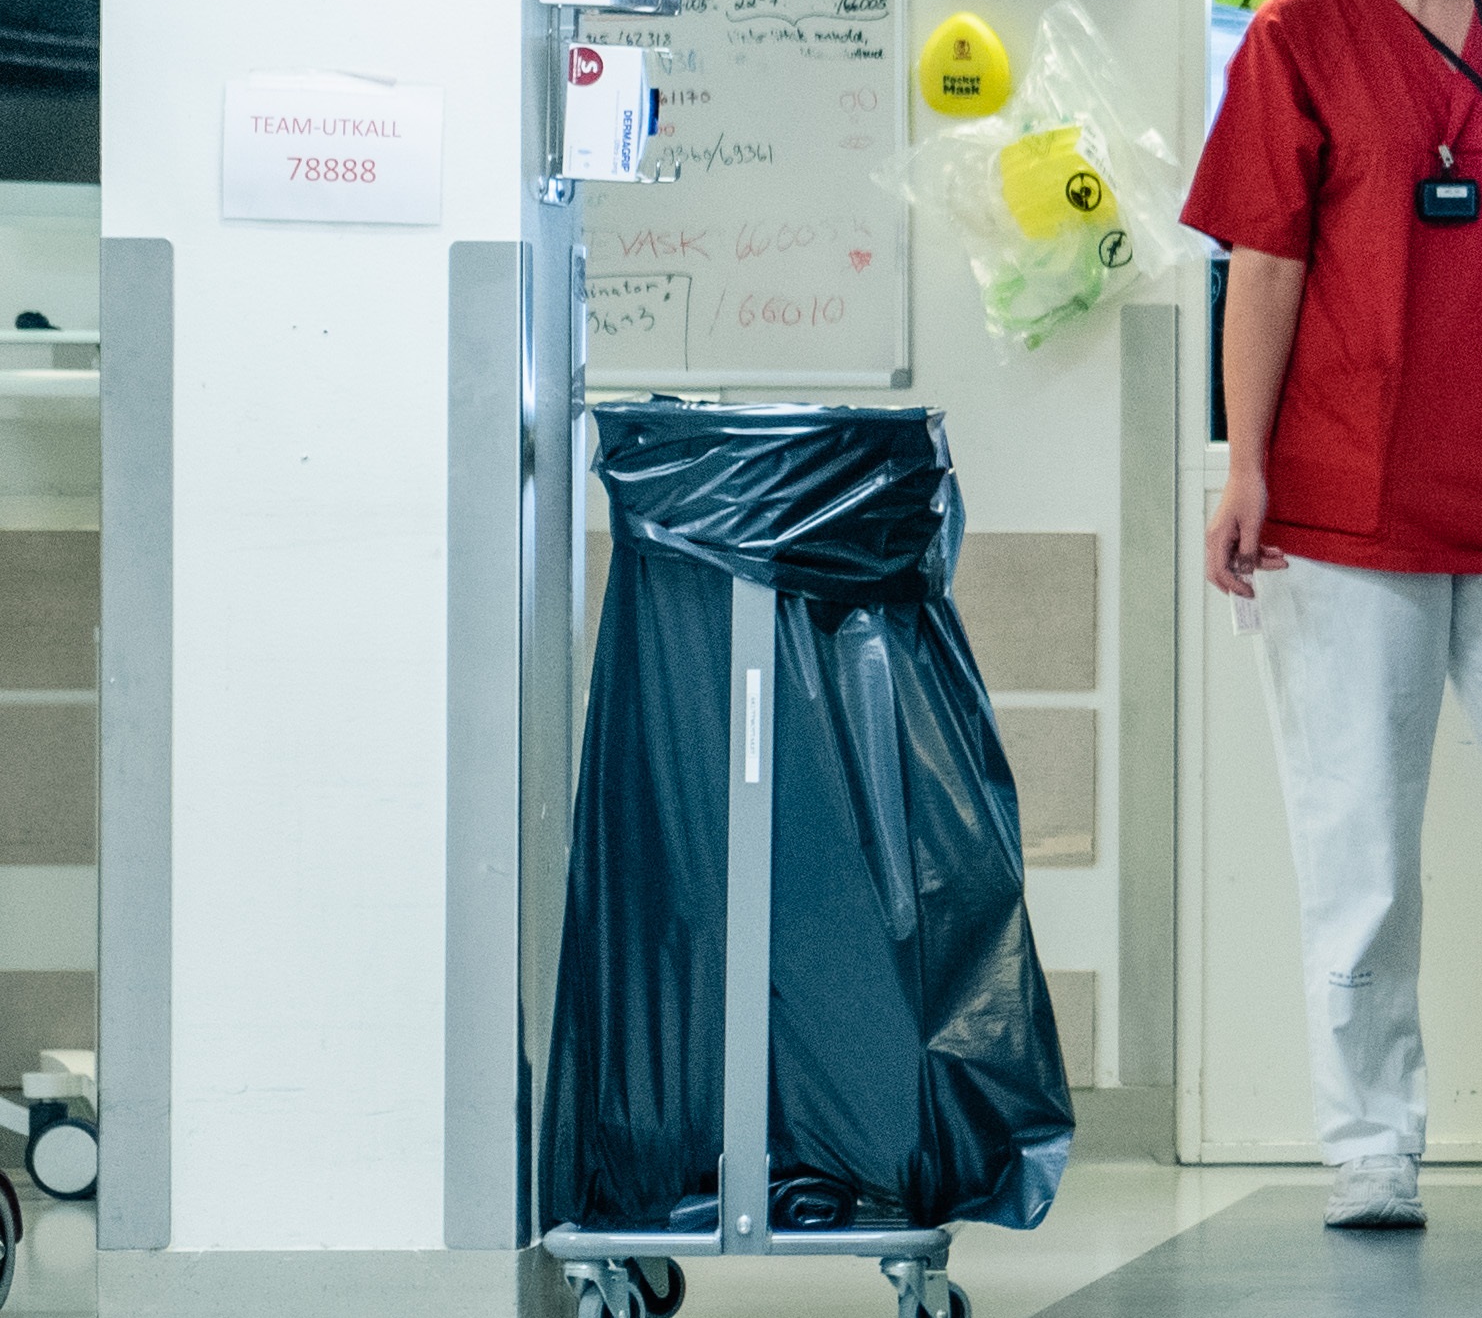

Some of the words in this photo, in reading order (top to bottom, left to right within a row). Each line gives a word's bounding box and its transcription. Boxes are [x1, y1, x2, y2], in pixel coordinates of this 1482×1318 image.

[580, 59, 599, 74] S
[942, 84, 981, 96] Mask
[250, 115, 402, 139] TEAM-UTKALL
[621, 109, 633, 173] DERMAGRIP
[286, 156, 377, 184] 78888
[618, 229, 712, 261] VASK
